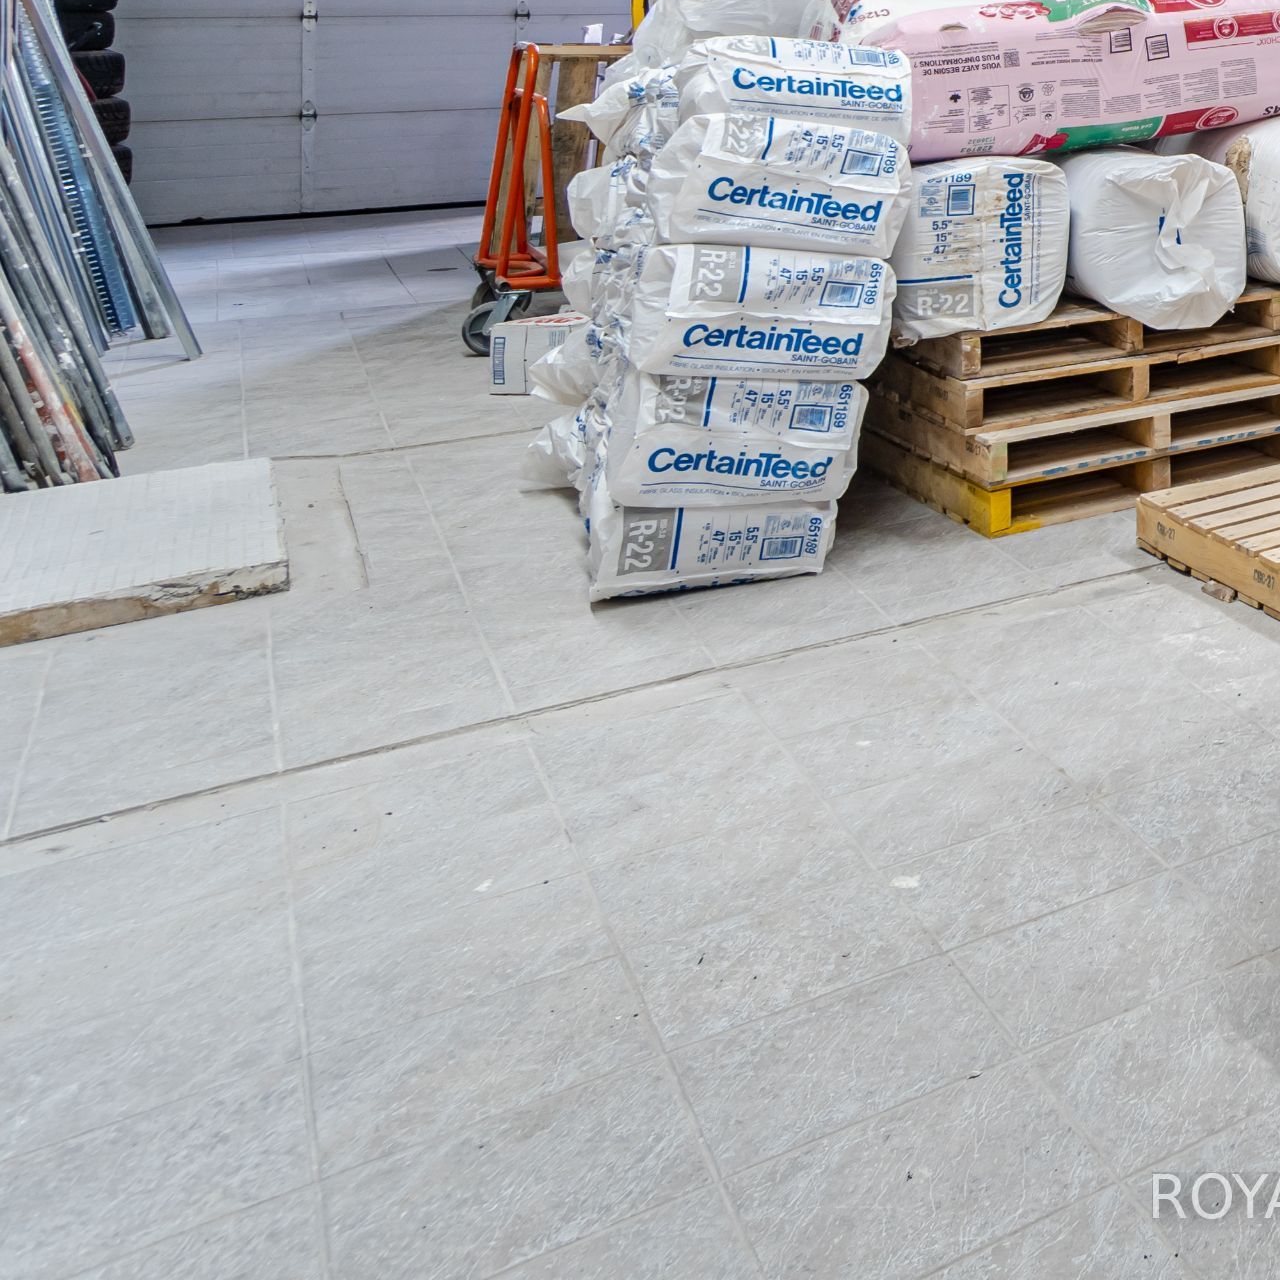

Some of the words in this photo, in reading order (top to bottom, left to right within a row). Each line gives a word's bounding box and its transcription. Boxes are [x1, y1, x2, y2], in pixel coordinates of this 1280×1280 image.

[922, 68, 932, 76] DE
[933, 66, 960, 75] BESOIN
[961, 64, 980, 73] AVEZ
[982, 62, 1002, 71] VOUS
[983, 53, 1001, 62] PLUS
[732, 67, 903, 103] CertainTeed
[840, 99, 903, 112] SAINT-GOBAIN
[707, 176, 884, 223] CertainTeed
[1023, 172, 1033, 222] SAINT-GOBAIN
[811, 216, 876, 233] SAINT-GOBAIN
[998, 172, 1025, 309] CertainTeed
[696, 248, 723, 297] R-22
[862, 262, 883, 306] 651189
[916, 292, 970, 318] R-22
[682, 323, 864, 357] CertainTeed
[790, 354, 858, 366] SAINT-GOBAIN
[832, 384, 854, 429] 651189
[647, 446, 834, 480] CertainTeed
[759, 476, 827, 489] SAINT-GOBAIN
[624, 518, 658, 572] R-22
[804, 516, 823, 556] 651189
